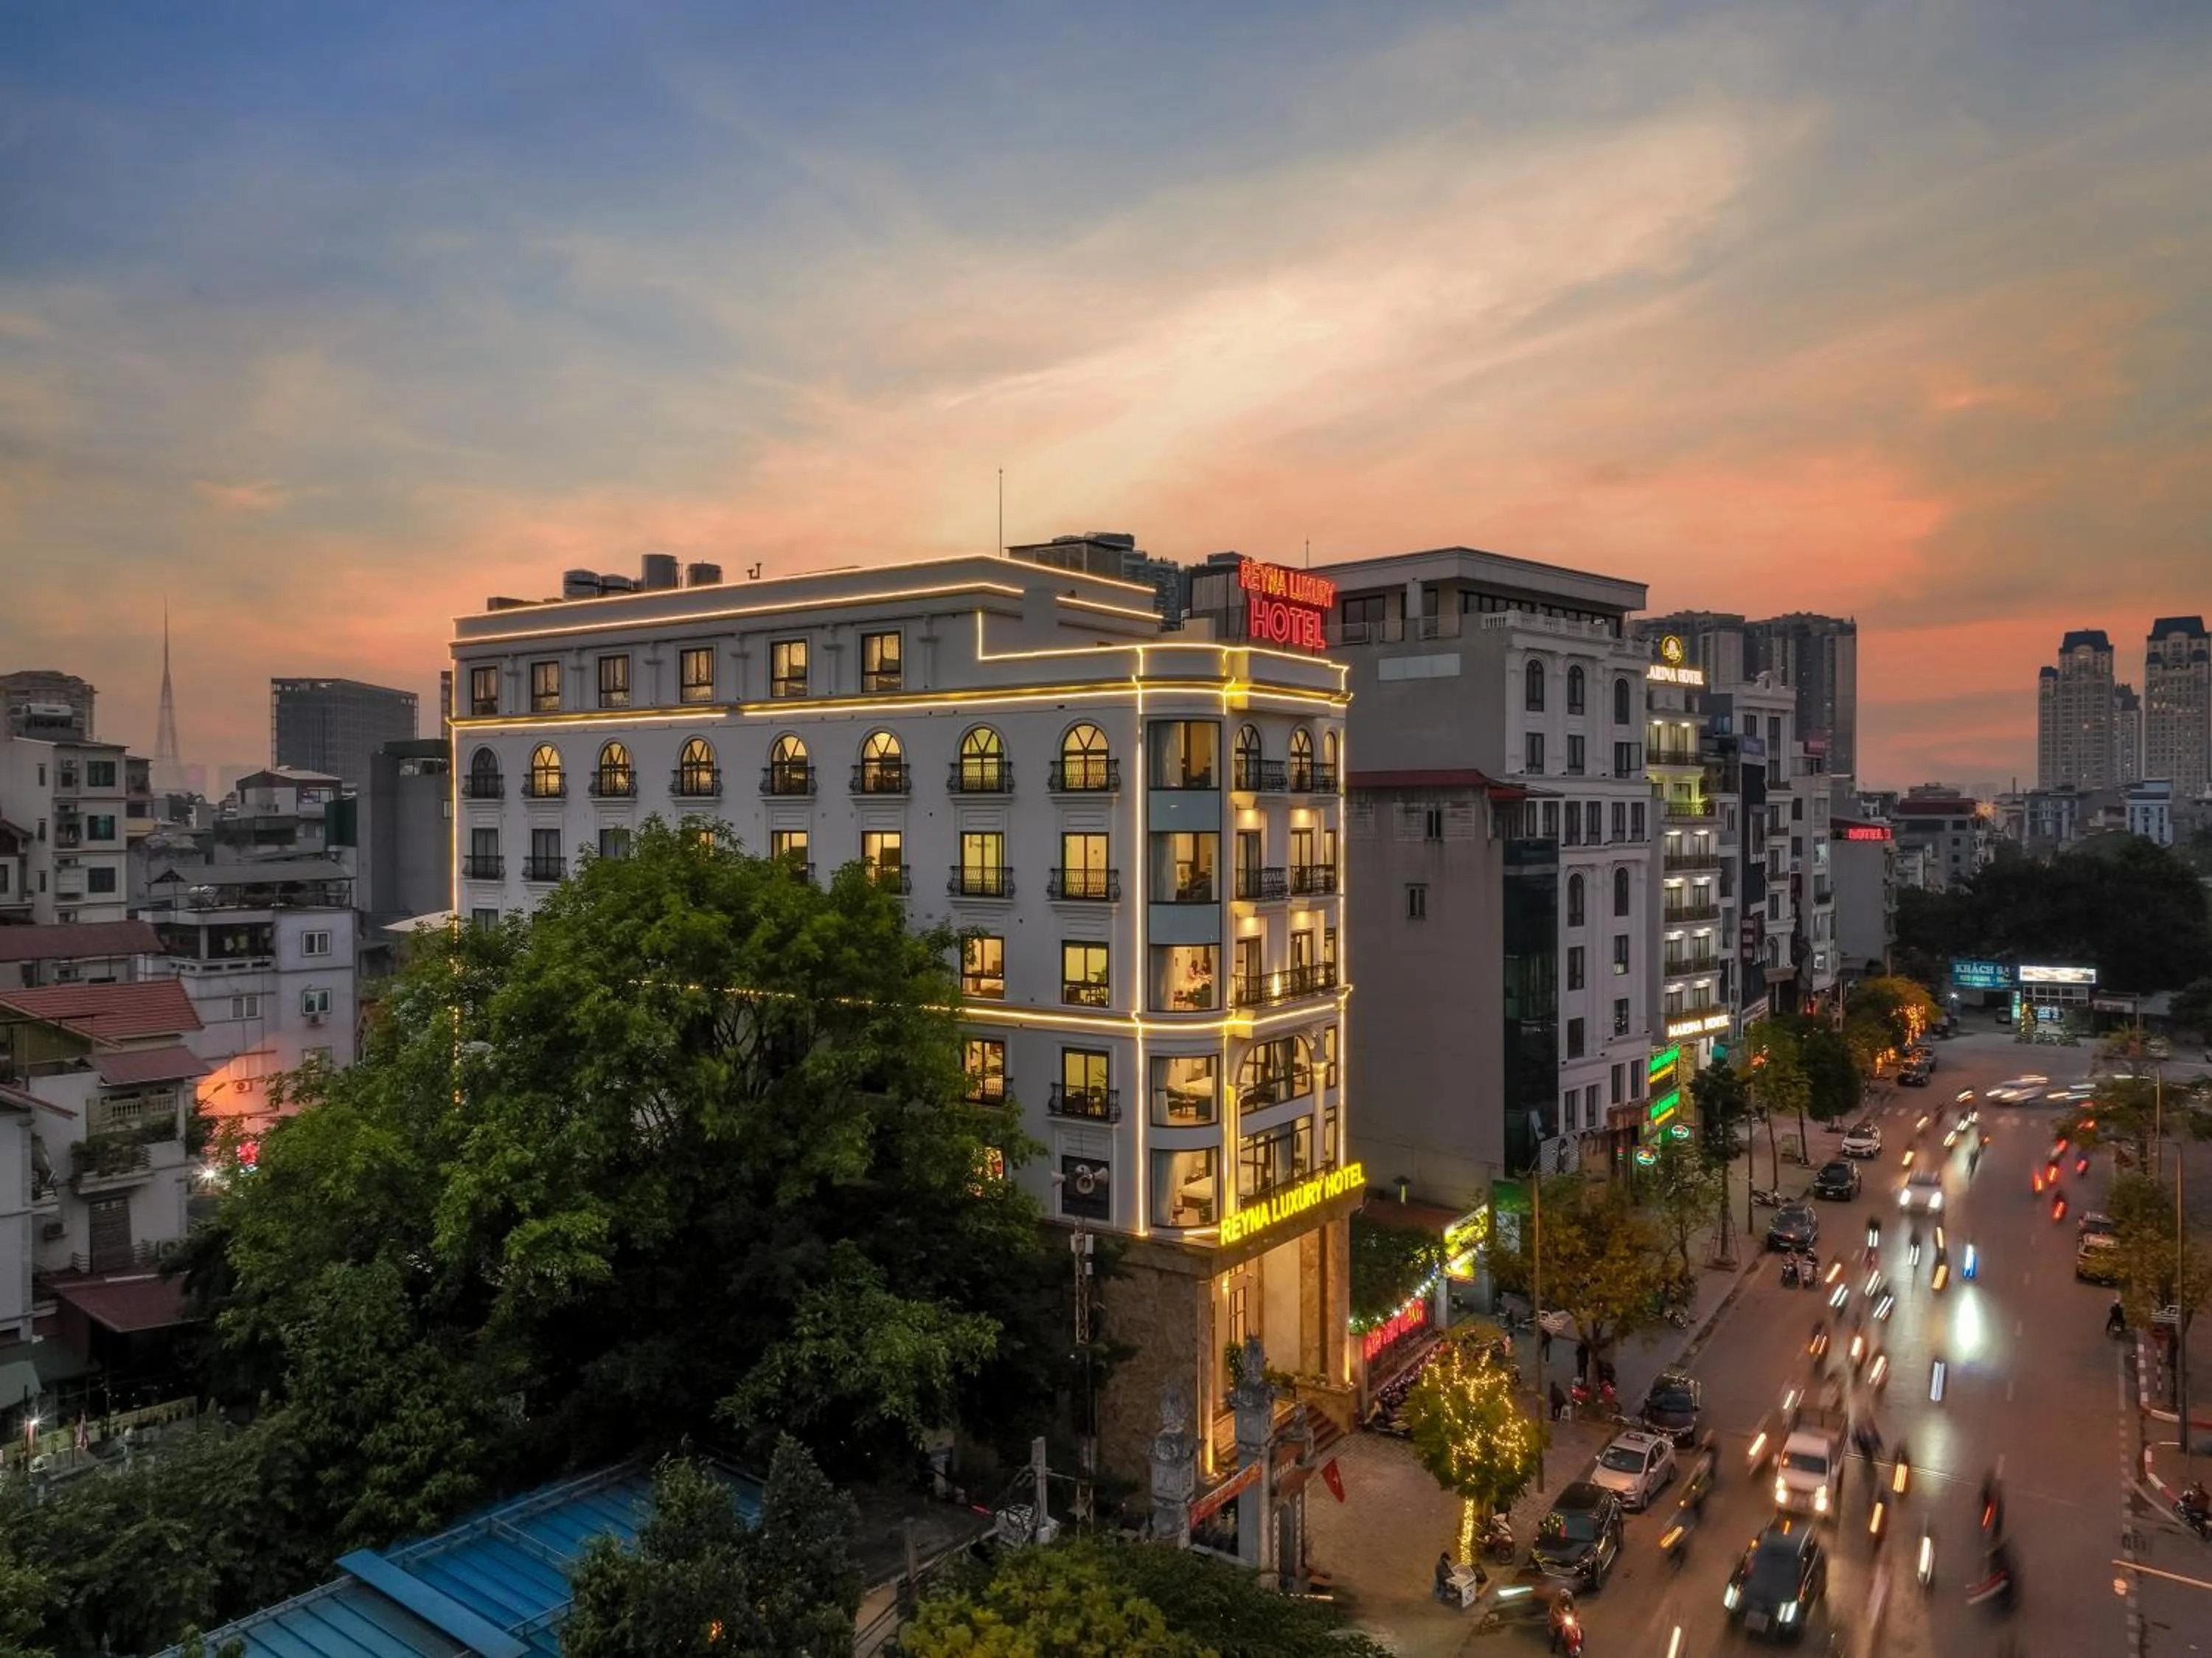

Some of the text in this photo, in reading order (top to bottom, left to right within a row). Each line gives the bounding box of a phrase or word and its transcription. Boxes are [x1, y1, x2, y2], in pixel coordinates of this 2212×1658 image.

[1240, 558, 1335, 608] REYNA LUXURY
[1250, 598, 1326, 649] HOTEL
[1955, 962, 1994, 974] KHÁCH
[1220, 1162, 1366, 1246] REYNA LUXURY HOTEL
